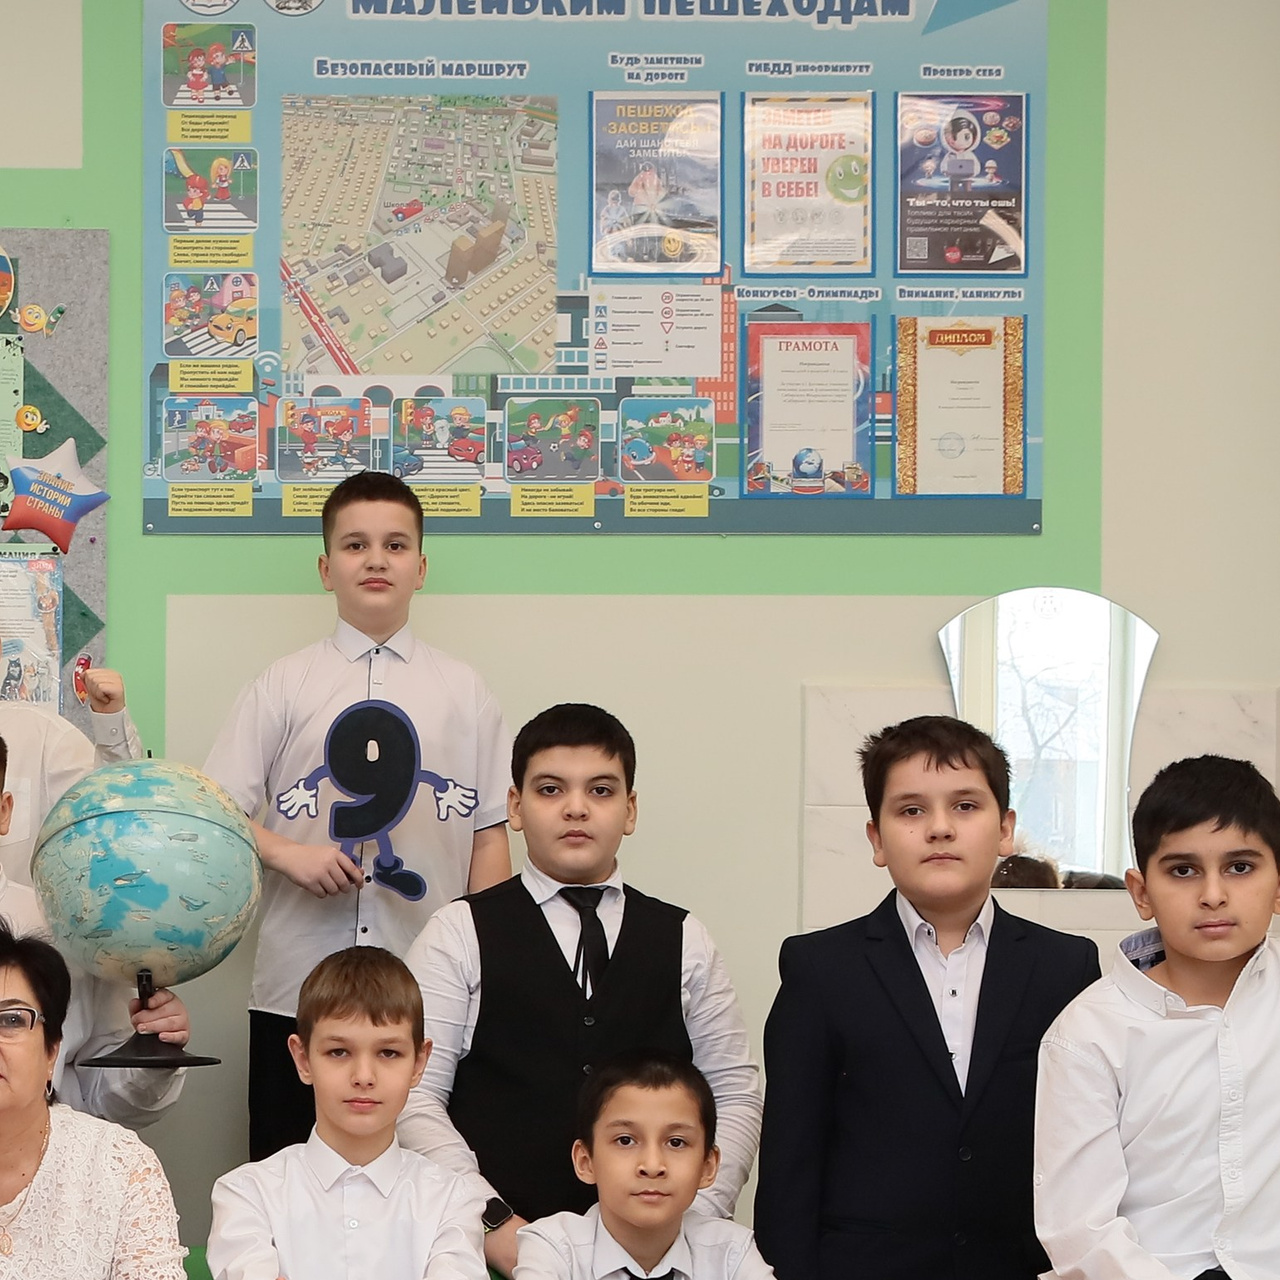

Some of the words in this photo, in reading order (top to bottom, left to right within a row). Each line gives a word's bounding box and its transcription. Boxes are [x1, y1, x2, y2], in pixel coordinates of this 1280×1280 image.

[627, 72, 641, 80] НА
[748, 63, 792, 75] ГИБДД
[616, 137, 637, 148] ДАЙ
[762, 133, 783, 150] НА
[786, 133, 846, 152] ДОРОГЕ
[762, 157, 818, 174] УВЕРЕН
[762, 181, 771, 198] В
[776, 181, 819, 198] СЕБЕ!
[973, 199, 990, 207] ты
[778, 341, 840, 352] ГРАМОТА
[935, 333, 986, 345] ДИПЛОМ
[38, 469, 75, 492] ЗНАНИЕ
[29, 484, 72, 507] ИСТОРИИ
[26, 495, 65, 520] СТРАНЫ
[323, 698, 422, 843] 9
